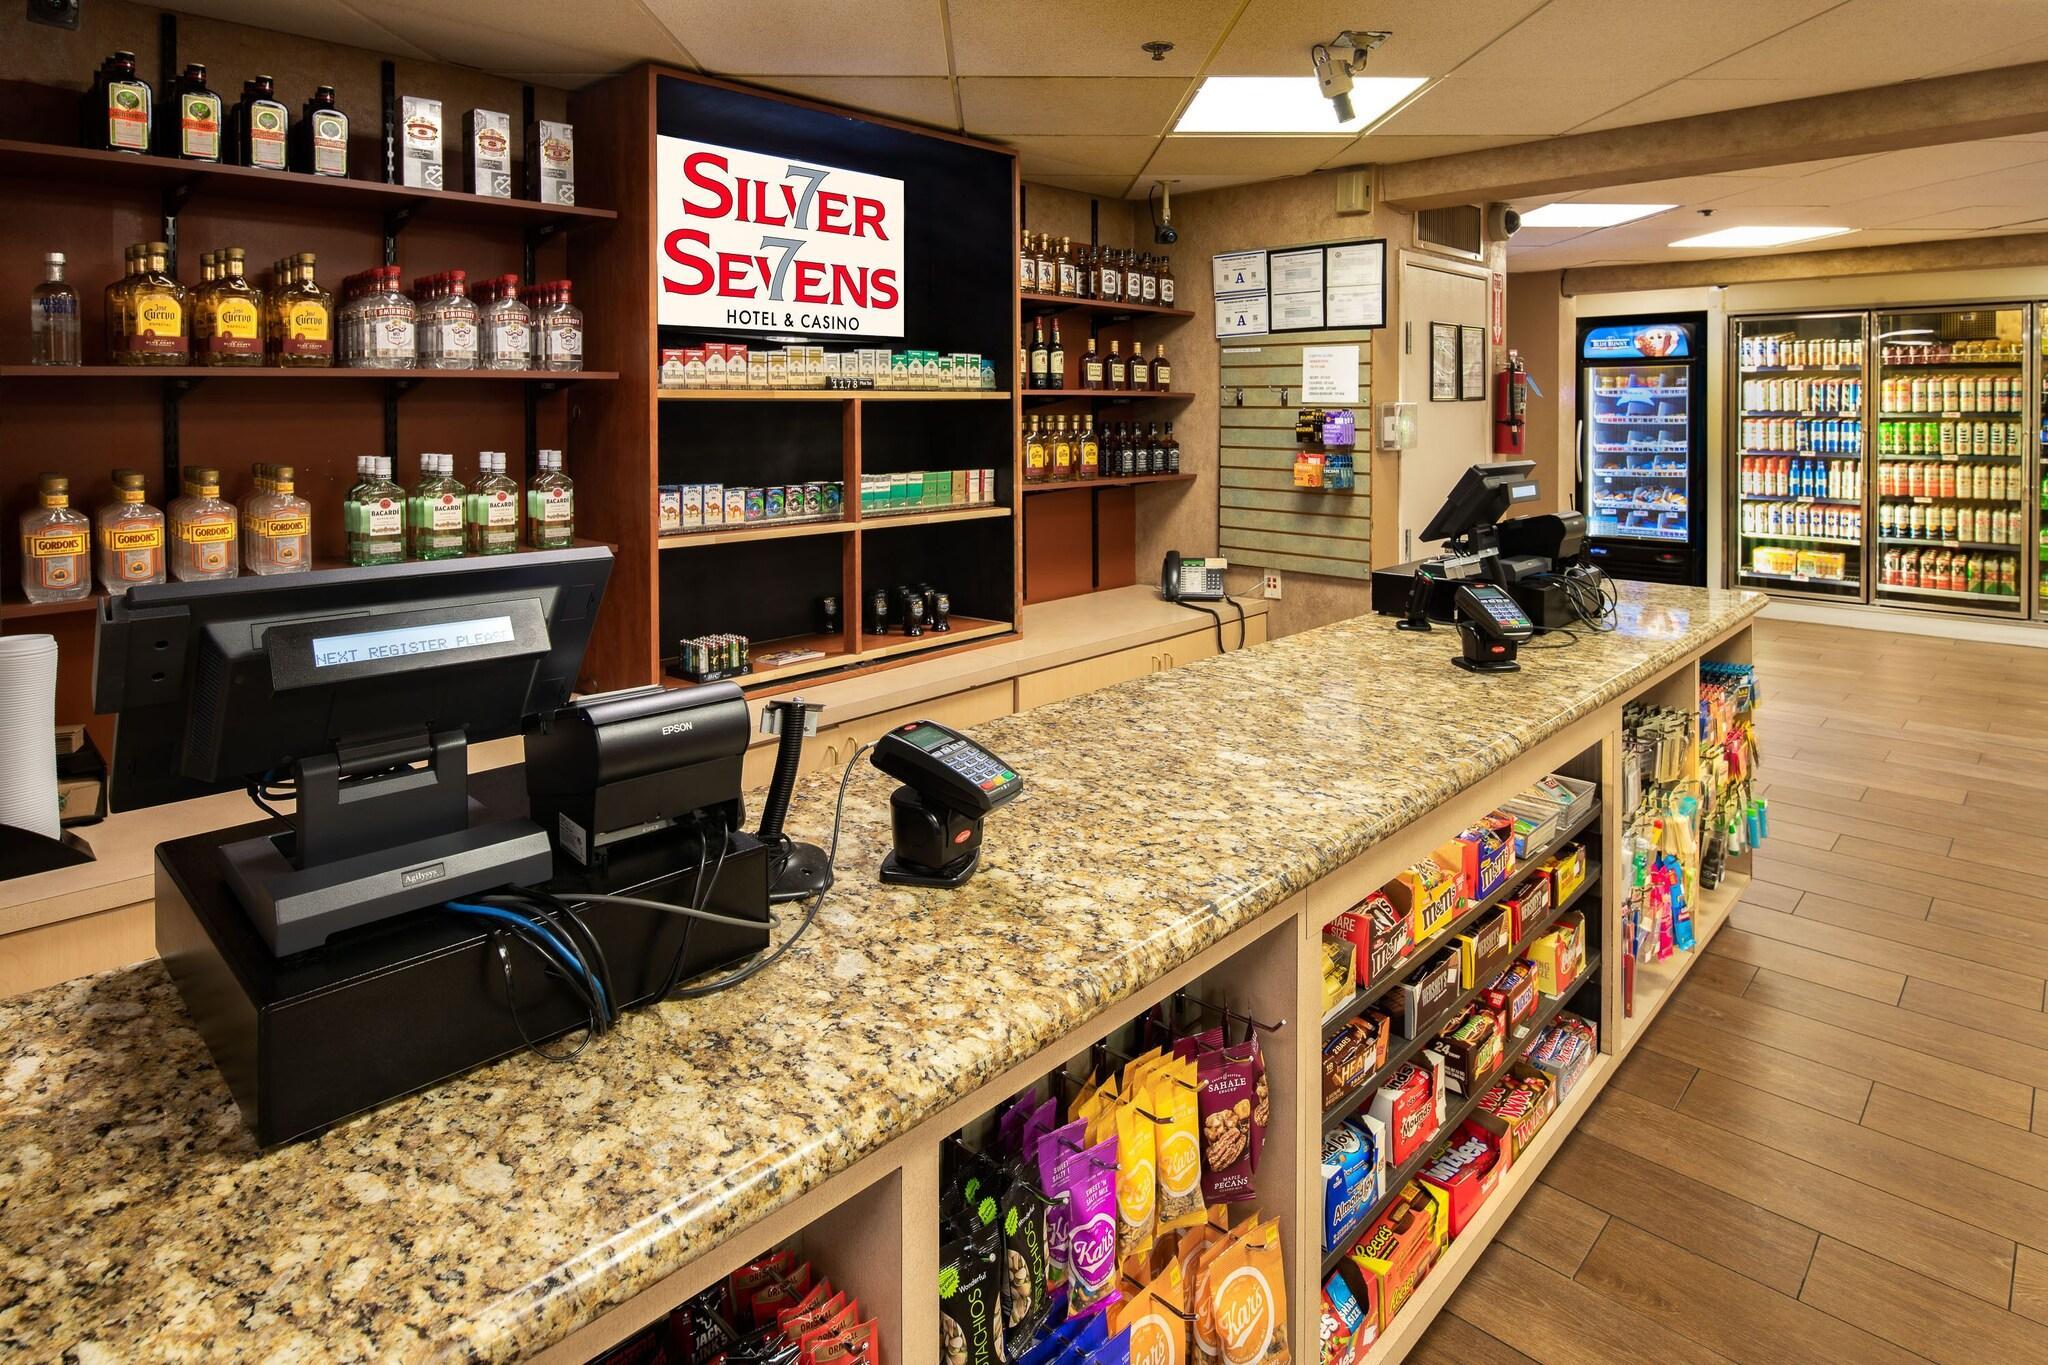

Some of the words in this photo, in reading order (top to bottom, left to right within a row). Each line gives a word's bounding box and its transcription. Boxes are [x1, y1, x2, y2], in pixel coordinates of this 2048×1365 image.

[1235, 272, 1245, 284] A
[144, 309, 175, 321] Cuervo
[222, 311, 251, 323] Cuervo
[295, 315, 323, 326] Cuervo
[444, 311, 476, 321] SMIRNOFF
[498, 313, 528, 322] SMIRNOFF
[727, 308, 777, 327] HOTEL
[784, 313, 794, 327] &
[801, 314, 859, 331] CASINO
[1237, 315, 1247, 326] A
[316, 650, 358, 666] NEXT
[368, 638, 447, 659] REGISTER
[662, 721, 693, 735] EPSON
[1434, 1041, 1451, 1055] 24
[1208, 1077, 1247, 1093] SAHALE
[1401, 1102, 1432, 1137] Mounds
[1214, 1177, 1248, 1190] PECANS
[1222, 1174, 1240, 1182] MAPLE
[1086, 1182, 1100, 1197] SWEET
[1086, 1193, 1098, 1206] SALTY
[1099, 1186, 1109, 1197] MIX
[1074, 1227, 1114, 1266] Kar's
[958, 1271, 987, 1294] Wonderful
[1222, 1282, 1263, 1347] Kar's
[1346, 1306, 1362, 1327] SIZE
[968, 1288, 989, 1365] TACHIOS
[696, 1325, 722, 1350] JACK
